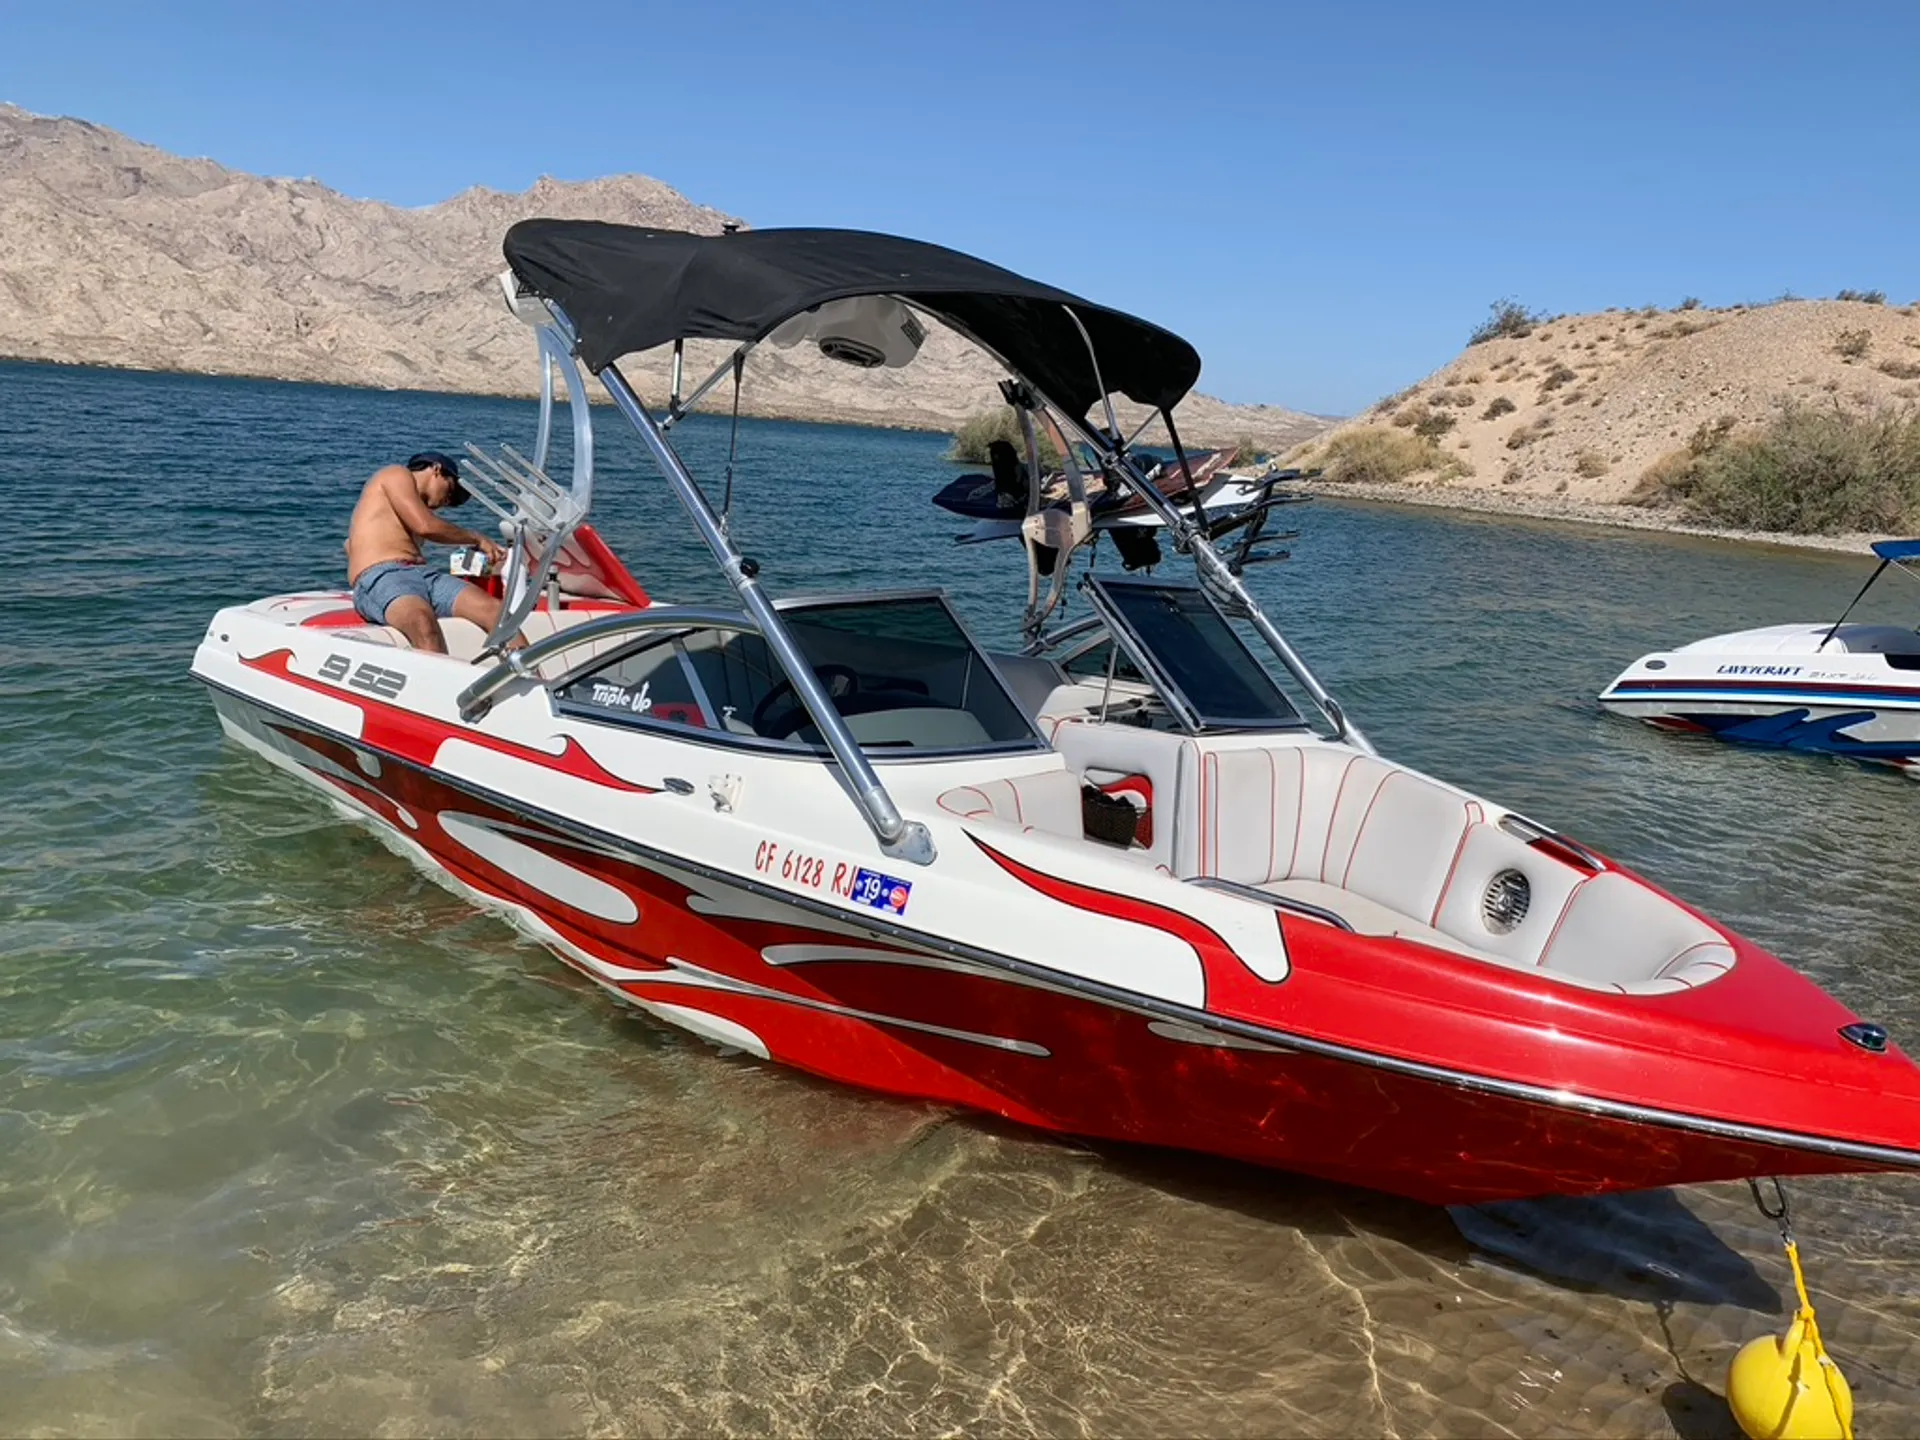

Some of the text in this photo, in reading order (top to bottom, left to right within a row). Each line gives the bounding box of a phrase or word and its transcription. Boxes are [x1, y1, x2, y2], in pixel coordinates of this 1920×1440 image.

[592, 683, 631, 706] Triple
[755, 840, 857, 897] CF 6128 RJ
[864, 877, 881, 900] 19
